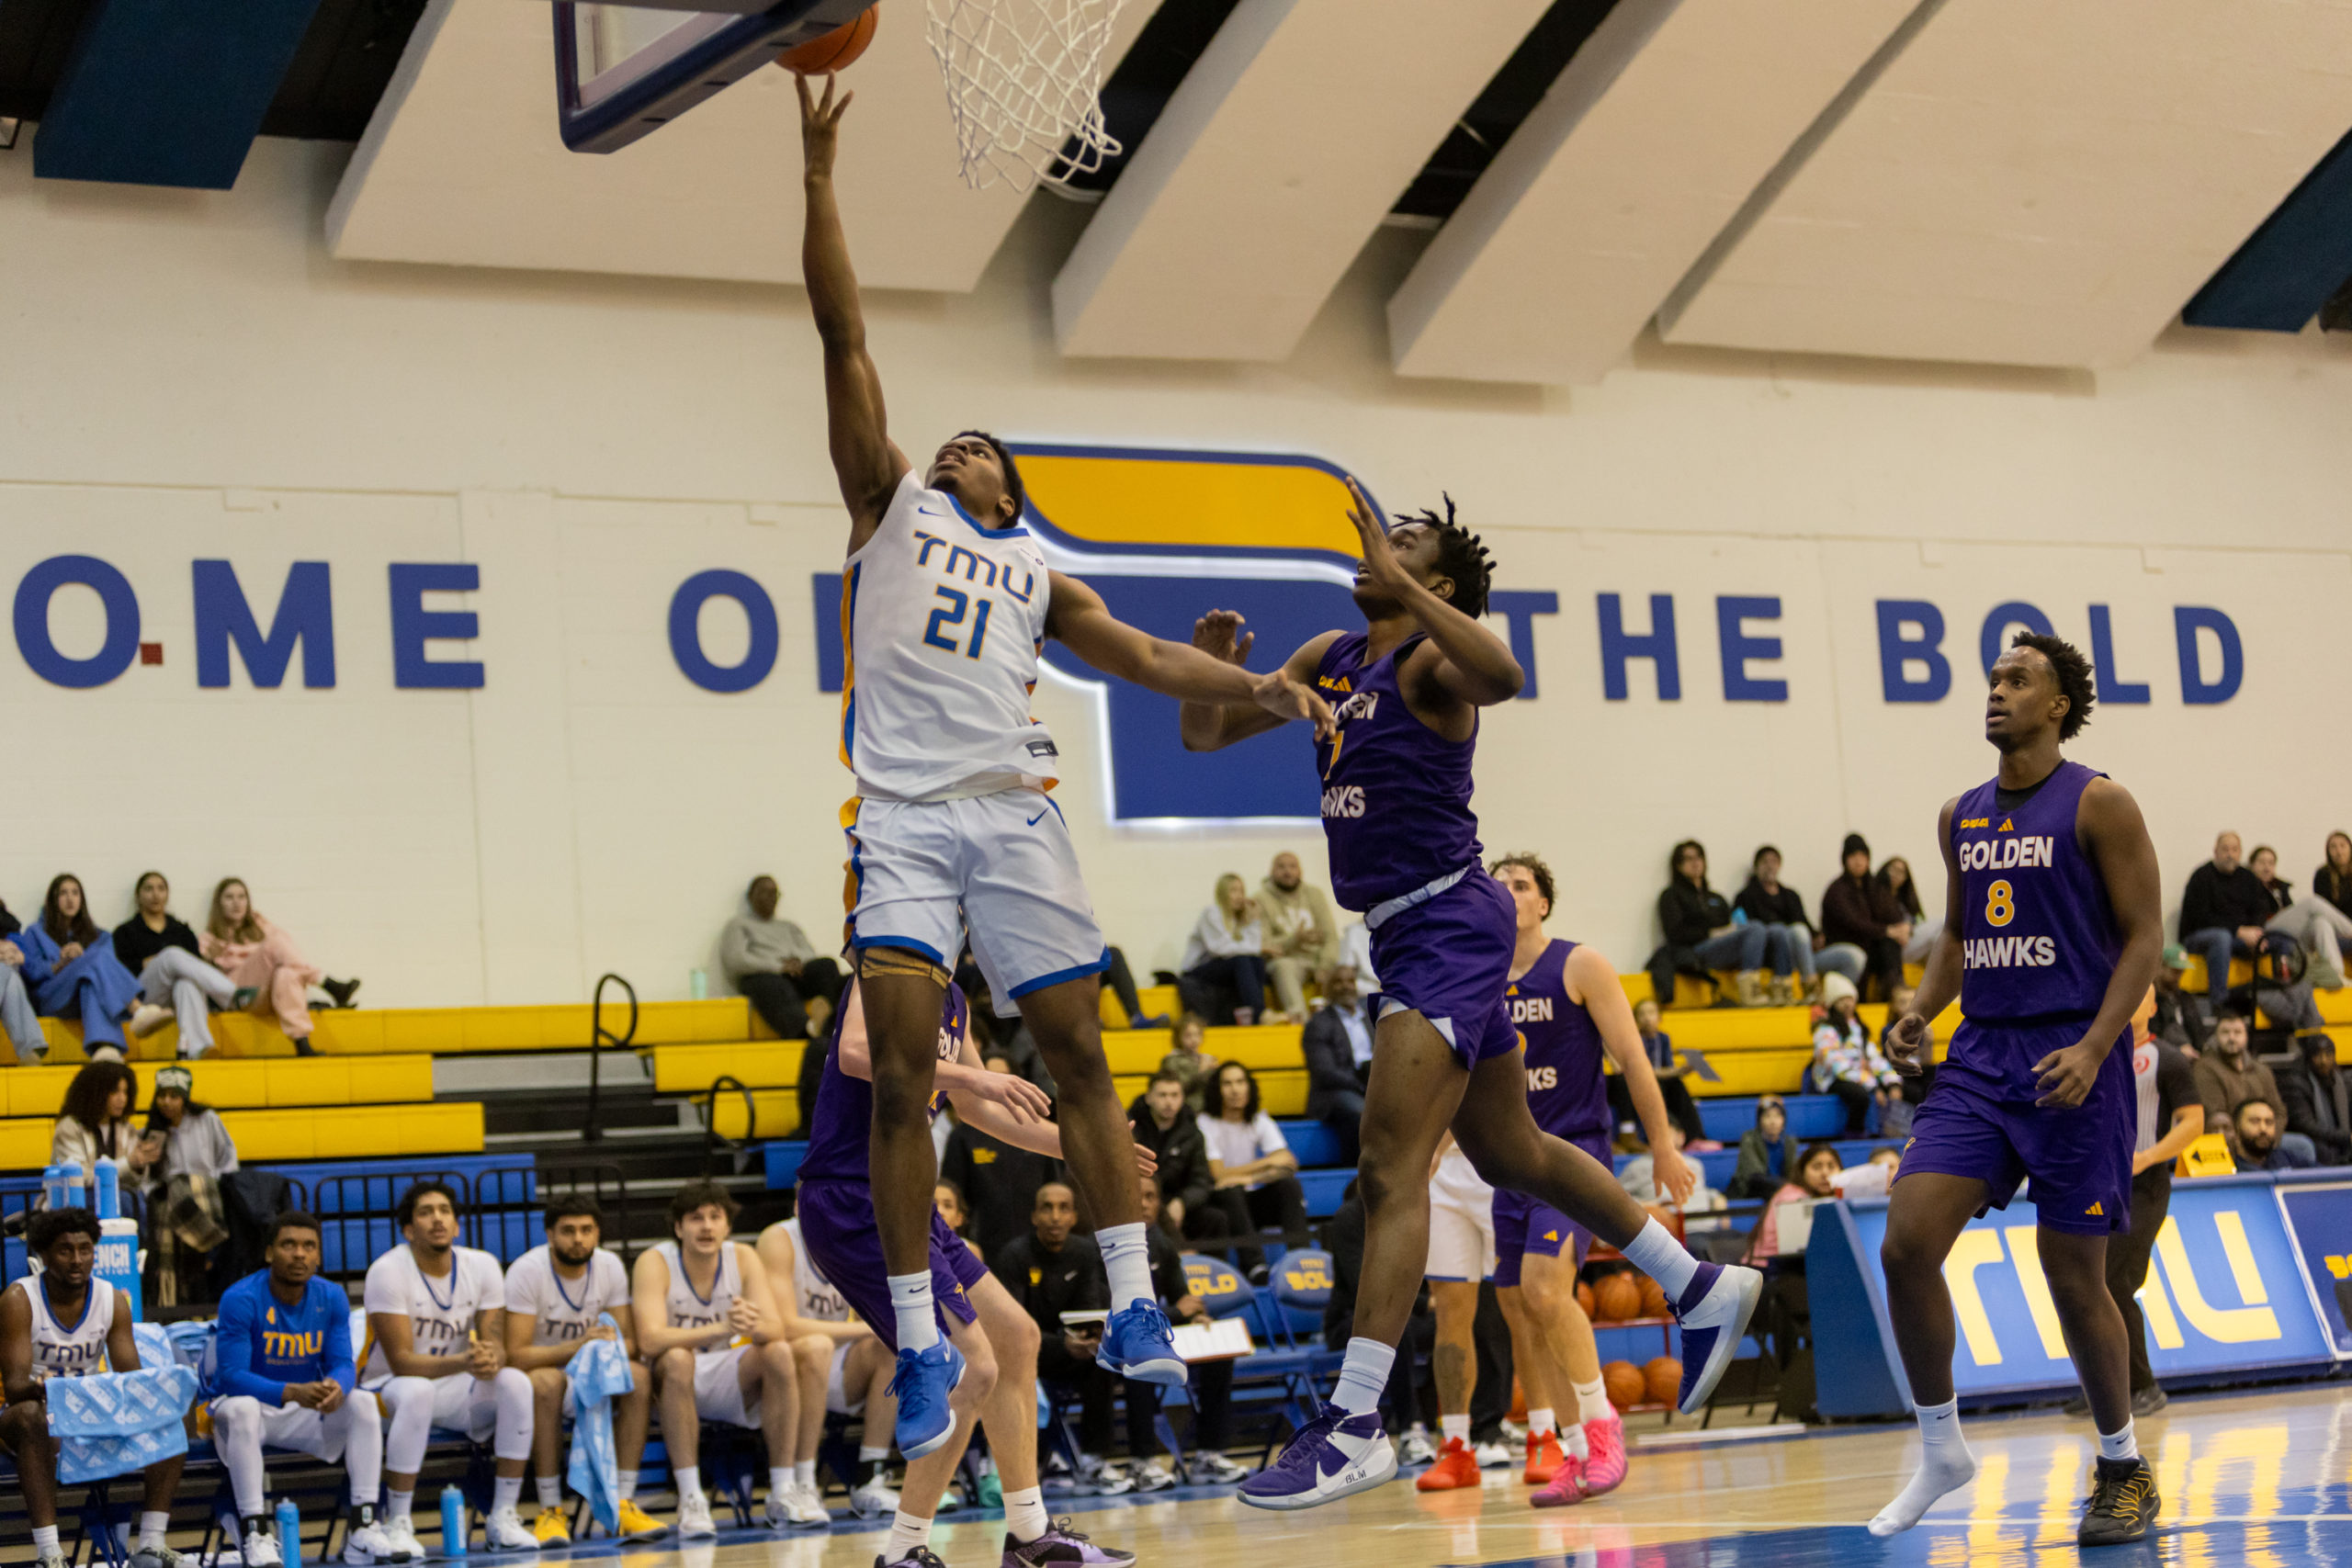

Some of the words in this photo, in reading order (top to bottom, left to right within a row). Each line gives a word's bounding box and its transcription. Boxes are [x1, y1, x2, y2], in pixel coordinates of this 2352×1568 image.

[913, 530, 1035, 604] TMU
[922, 583, 992, 661] 21
[1488, 591, 1790, 701] THE
[1960, 836, 2054, 872] GOLDEN
[1985, 879, 2015, 927] 8
[1963, 936, 2056, 969] HAWKS
[1505, 998, 1554, 1023] DEN
[93, 1244, 130, 1269] ENCH
[1188, 1274, 1238, 1296] OLD
[1285, 1271, 1333, 1291] BOL
[1940, 1210, 2282, 1367] TMU
[545, 1316, 591, 1339] TM
[38, 1338, 104, 1362] TMU
[263, 1330, 323, 1358] TMU
[1345, 1470, 1367, 1484] BLM
